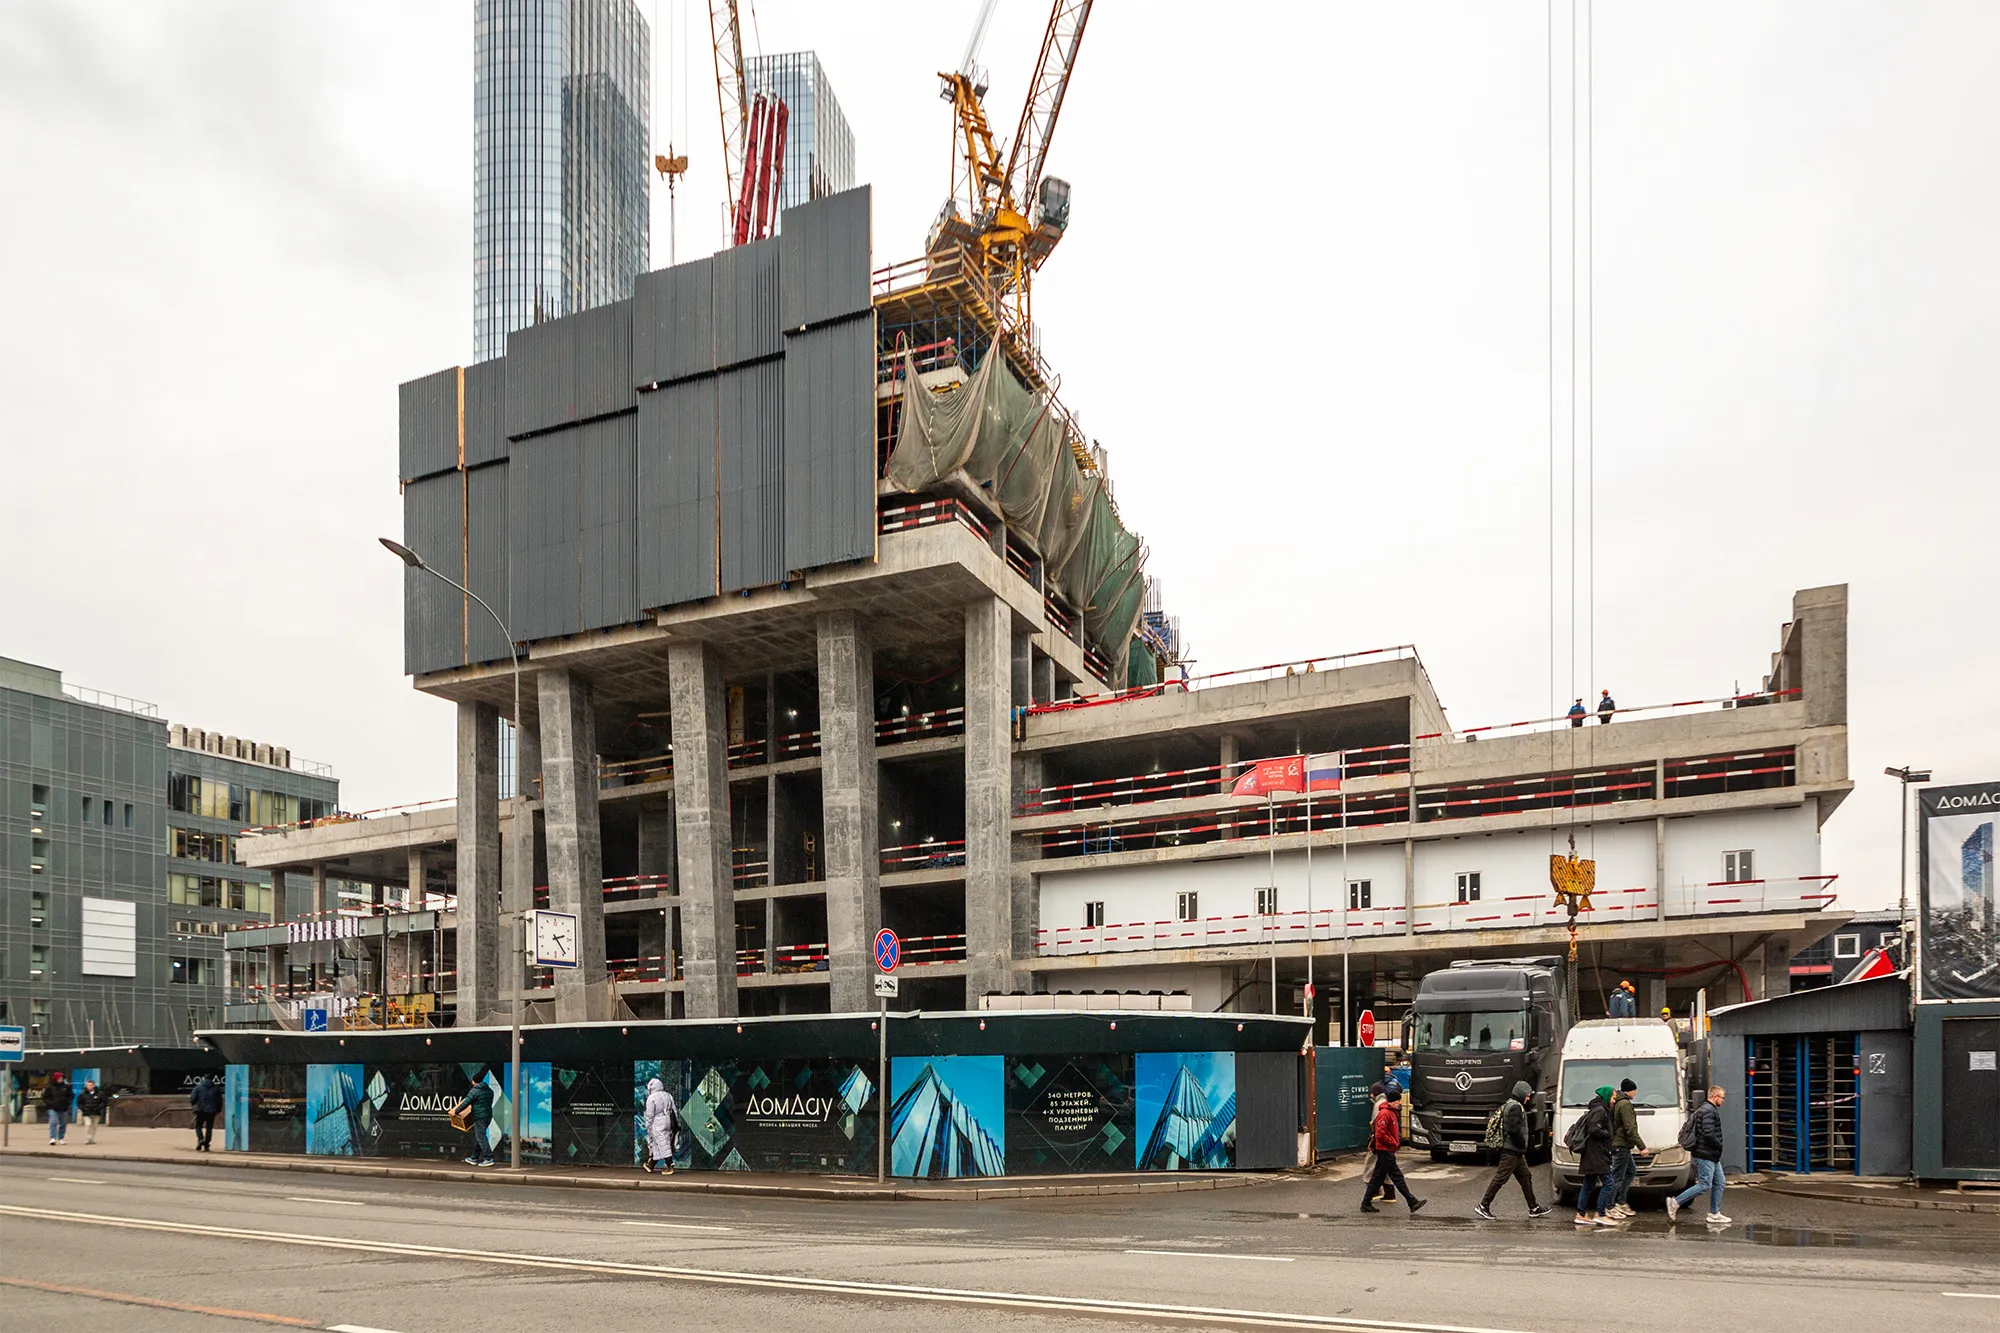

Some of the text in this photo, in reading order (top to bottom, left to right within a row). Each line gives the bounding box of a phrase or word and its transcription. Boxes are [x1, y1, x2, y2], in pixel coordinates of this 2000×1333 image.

[1362, 1023, 1374, 1034] STOP
[1060, 1098, 1092, 1107] ЭТАЖЕЙ.
[1056, 1106, 1099, 1115] УРОВНЕВЫЙ
[1048, 1115, 1093, 1124] ПОДЗЕМНЫЙ
